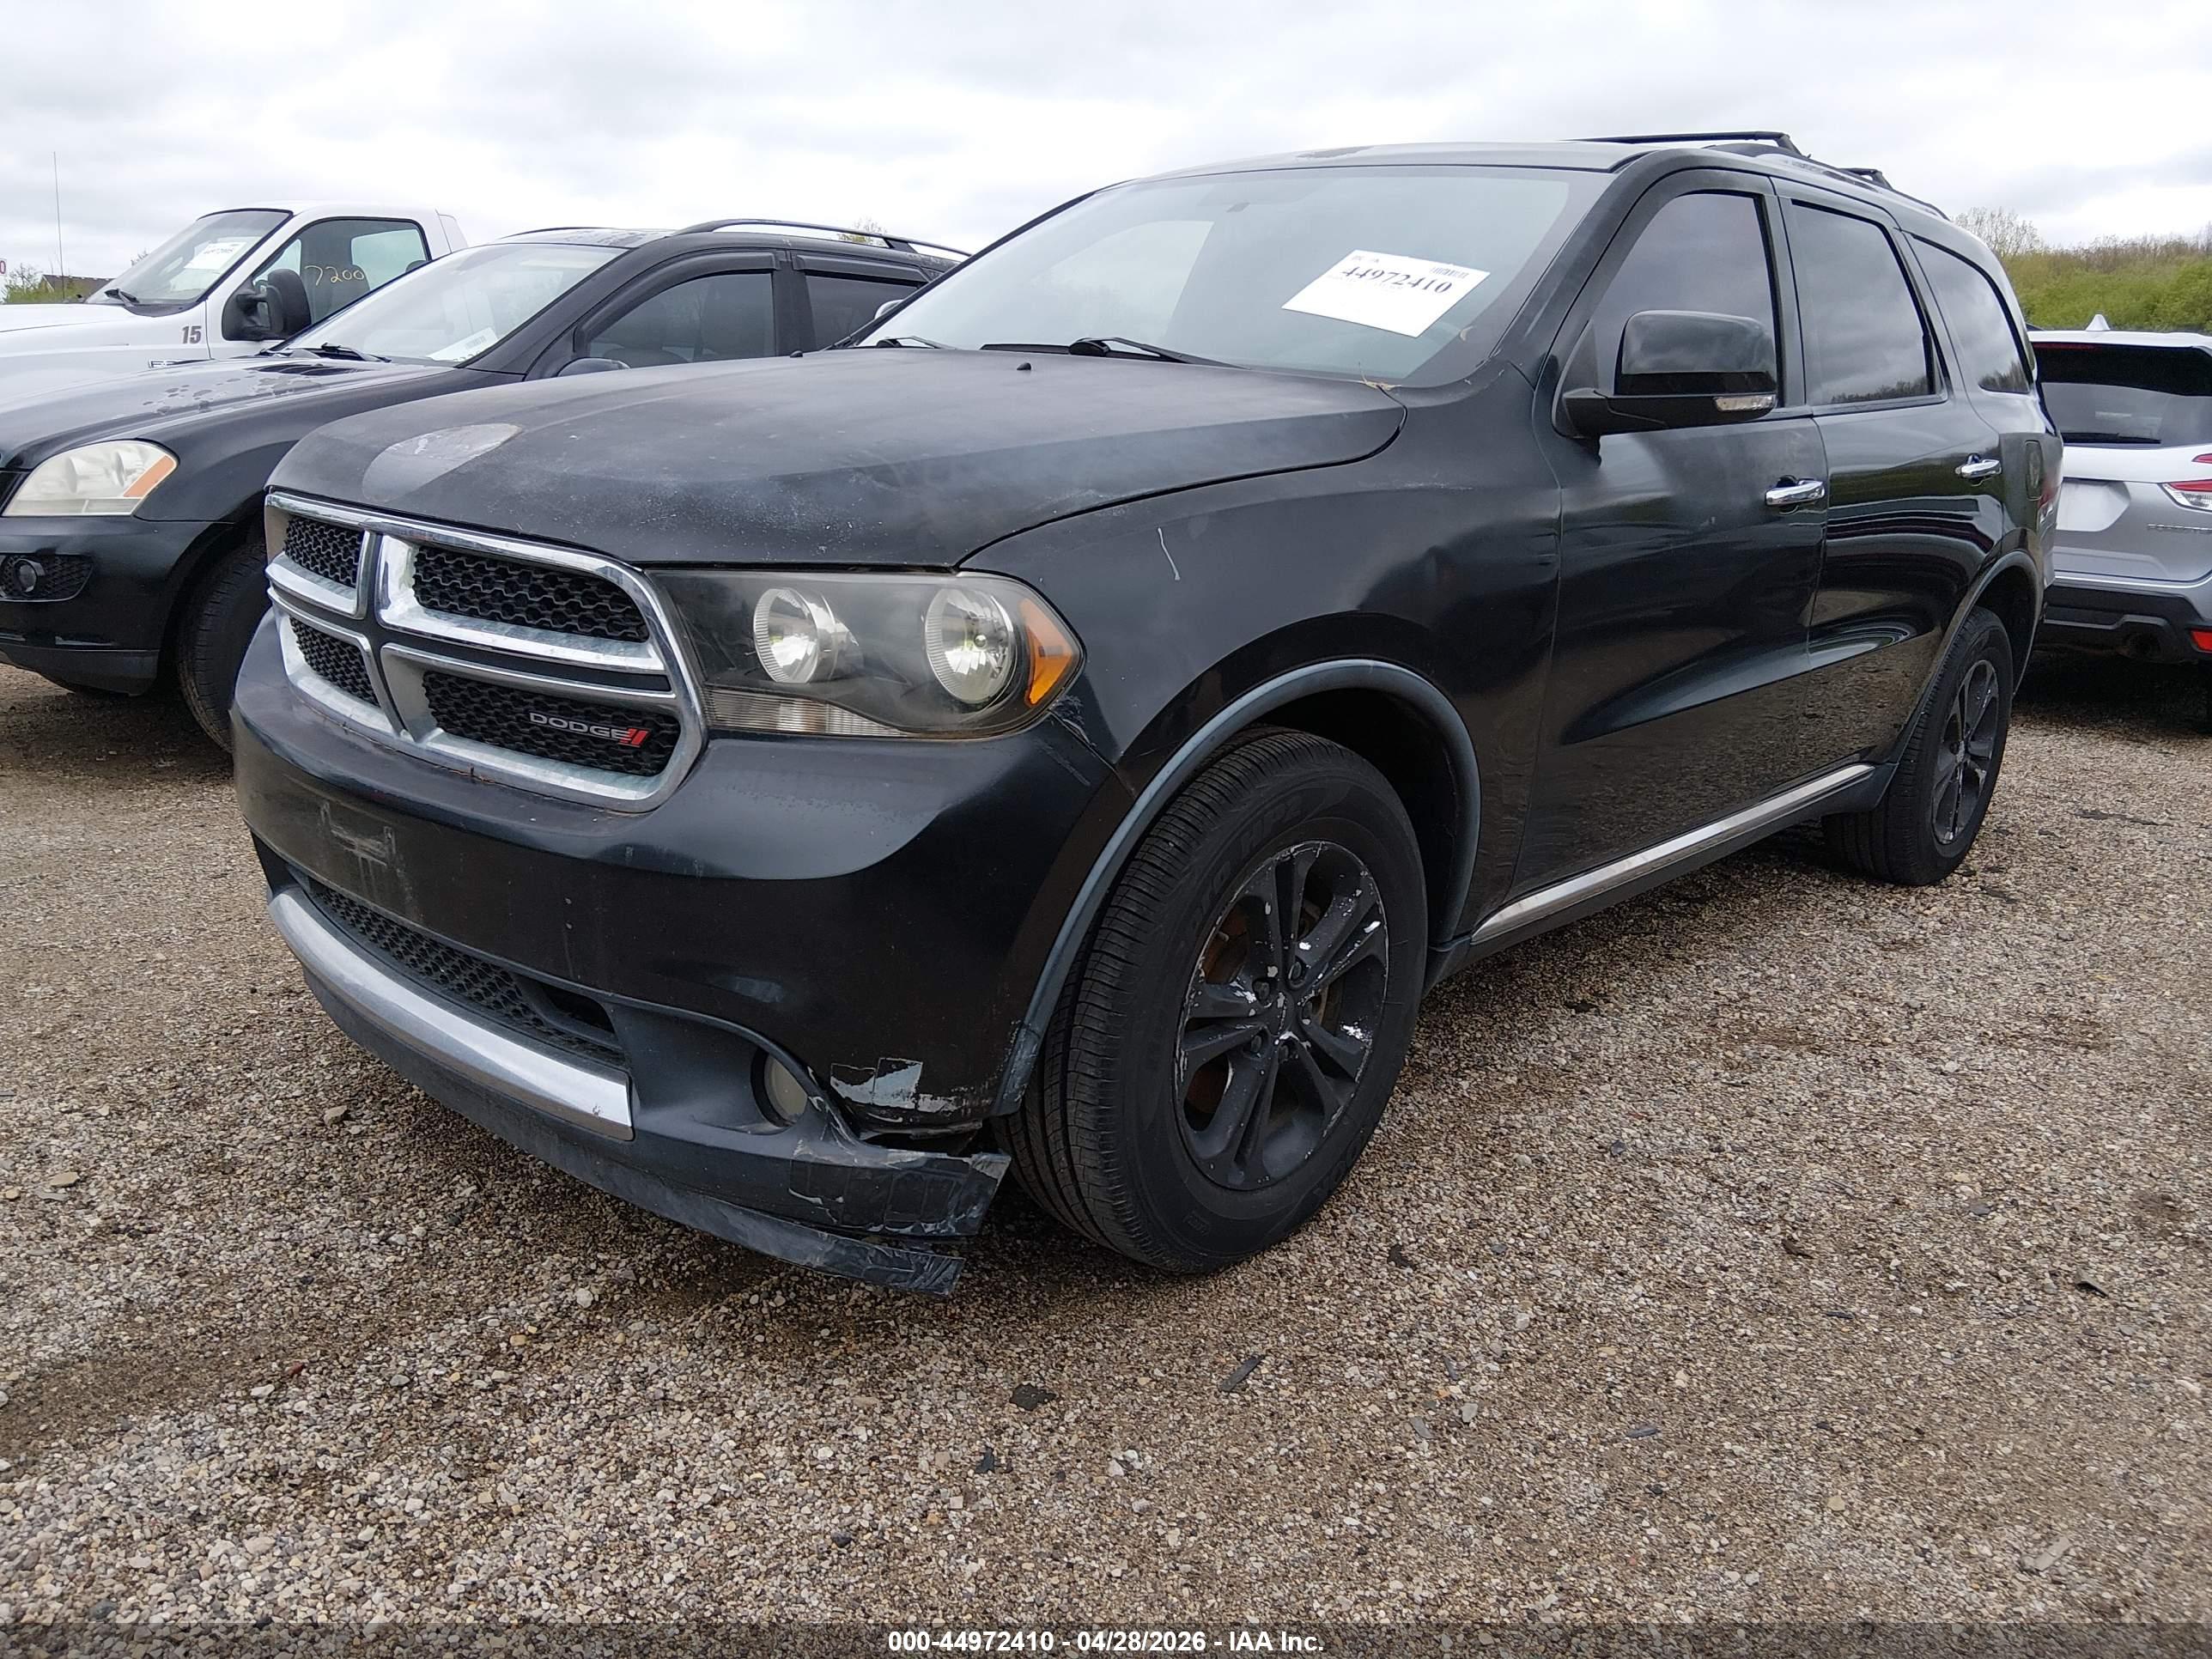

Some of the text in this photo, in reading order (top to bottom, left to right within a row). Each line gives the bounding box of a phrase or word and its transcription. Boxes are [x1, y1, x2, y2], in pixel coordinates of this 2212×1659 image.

[304, 264, 365, 286] 7200
[1341, 266, 1453, 294] 44972410
[182, 325, 202, 344] 15
[529, 712, 632, 741] DODGE
